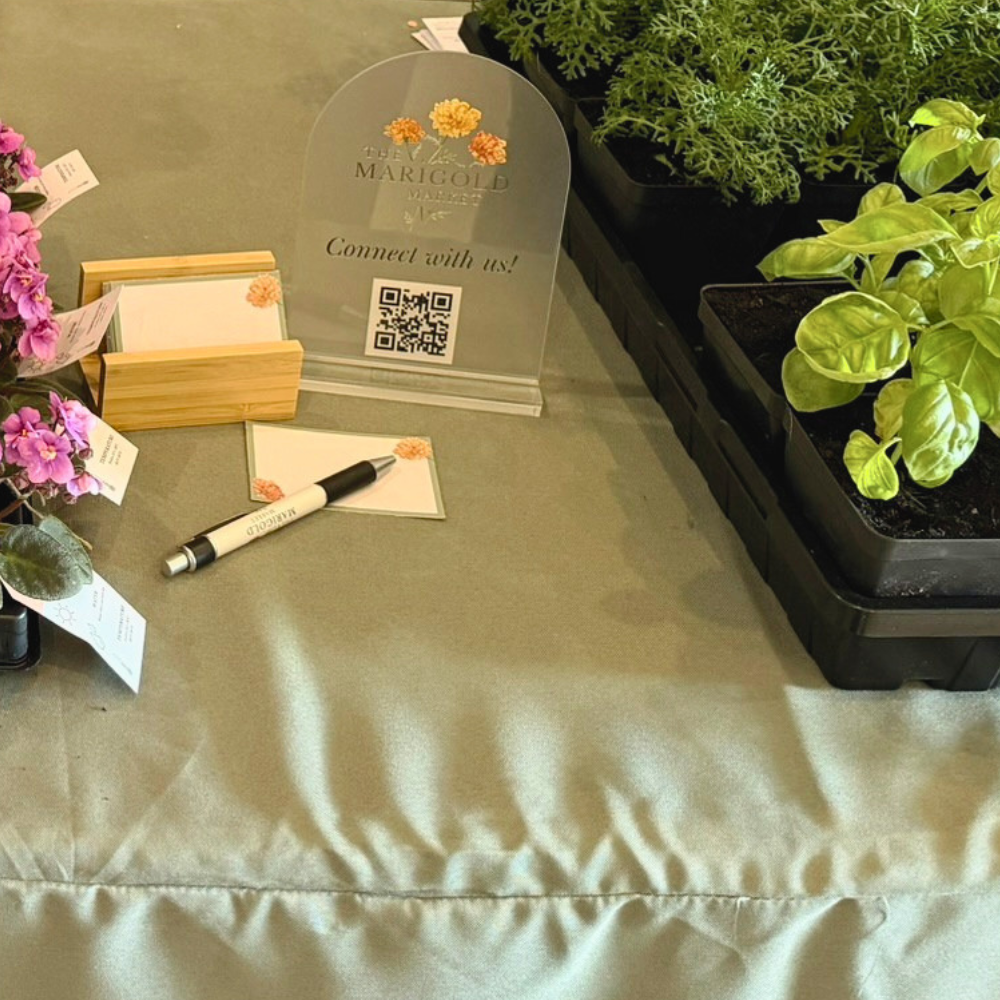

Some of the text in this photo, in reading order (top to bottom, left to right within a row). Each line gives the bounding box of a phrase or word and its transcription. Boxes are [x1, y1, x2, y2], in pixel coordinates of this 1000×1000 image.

[354, 161, 510, 193] MARIGOLD
[325, 235, 520, 275] Connect with us!
[246, 505, 298, 538] MARIGOLD
